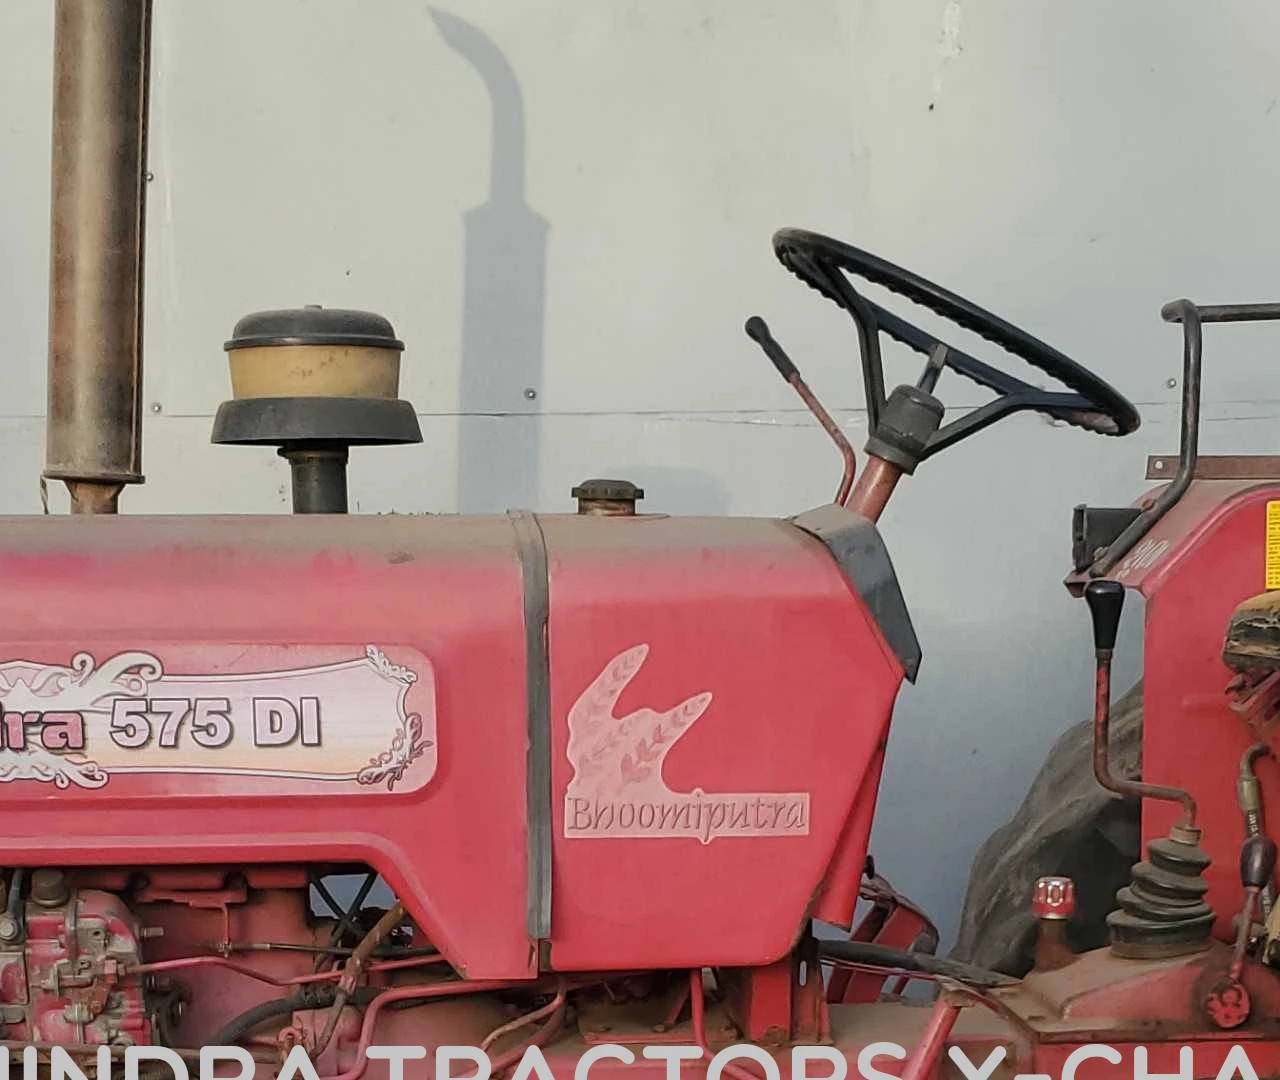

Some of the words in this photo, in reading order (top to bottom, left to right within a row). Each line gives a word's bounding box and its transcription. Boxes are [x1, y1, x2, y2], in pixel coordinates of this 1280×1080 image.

[109, 697, 234, 748] 575
[252, 697, 323, 747] DI
[567, 794, 807, 842] Bhoomiputra
